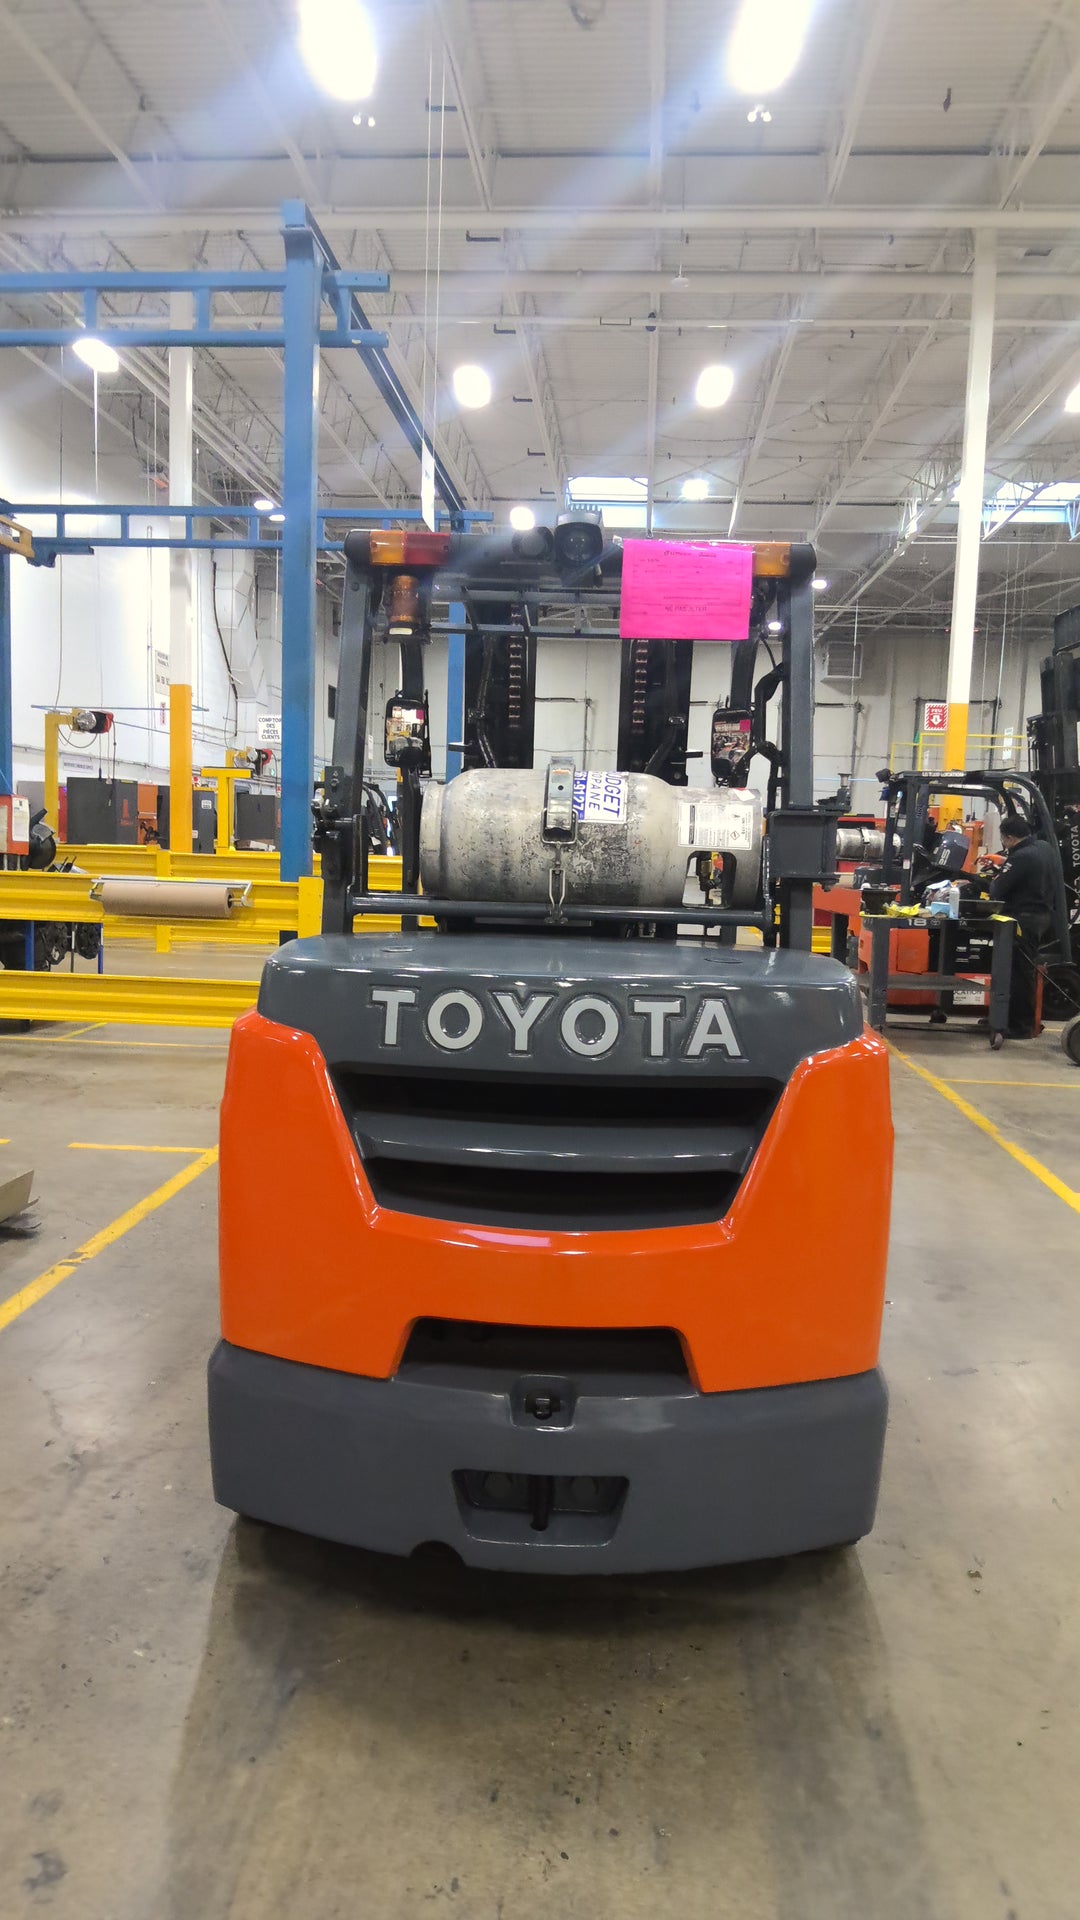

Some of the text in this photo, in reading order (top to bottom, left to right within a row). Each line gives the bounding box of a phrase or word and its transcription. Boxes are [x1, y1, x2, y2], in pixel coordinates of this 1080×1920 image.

[589, 770, 602, 810] OPANE
[603, 770, 622, 818] UDGET
[1070, 825, 1080, 868] TOYOTA
[907, 918, 927, 927] 18
[371, 990, 741, 1058] TOYOTA
